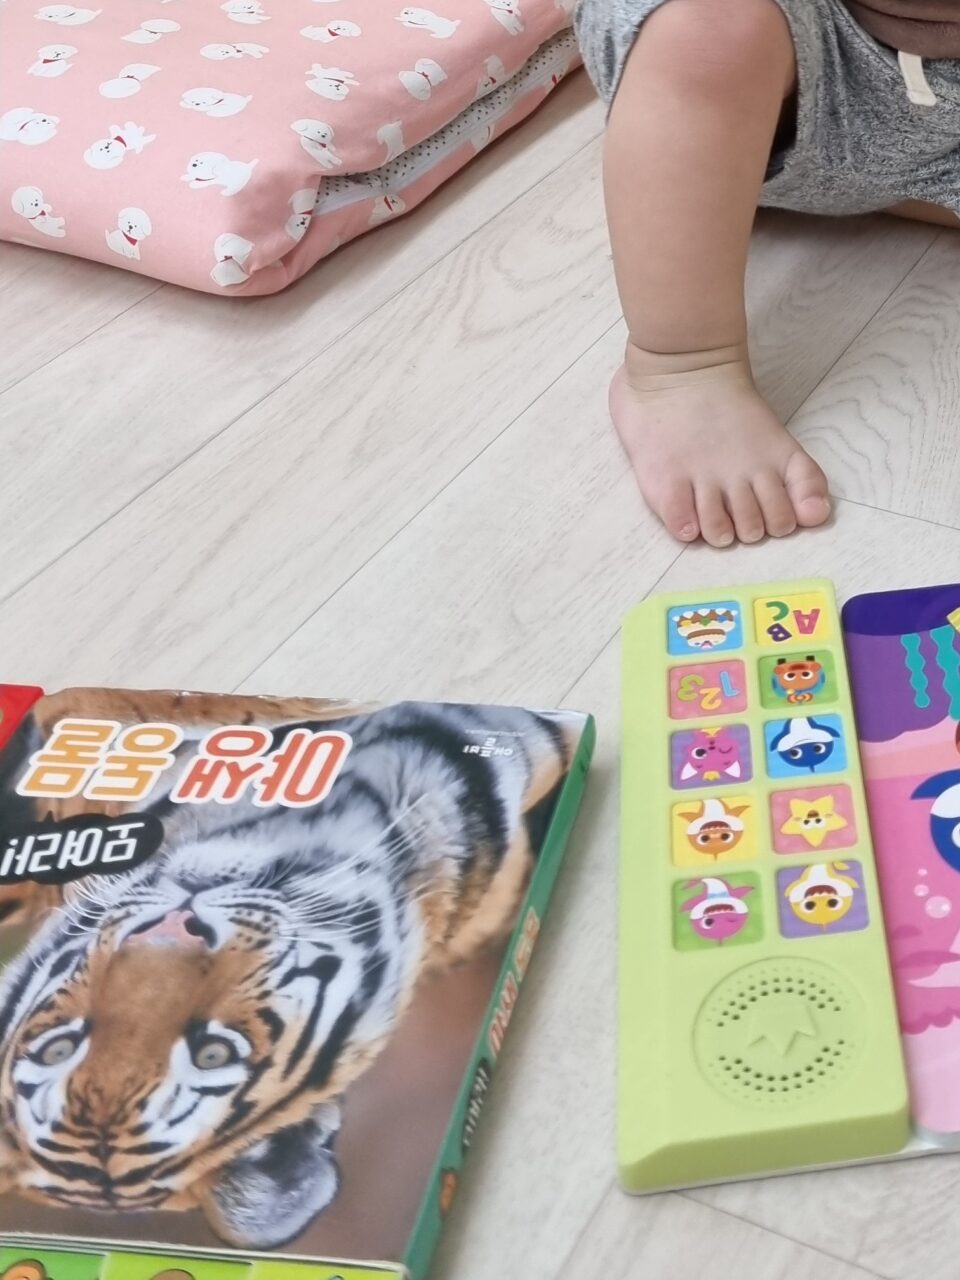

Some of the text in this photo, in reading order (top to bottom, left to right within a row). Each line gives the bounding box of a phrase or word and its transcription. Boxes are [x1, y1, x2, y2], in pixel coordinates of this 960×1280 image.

[15, 718, 352, 808] 야생 동물
[0, 822, 145, 877] 모여라!
